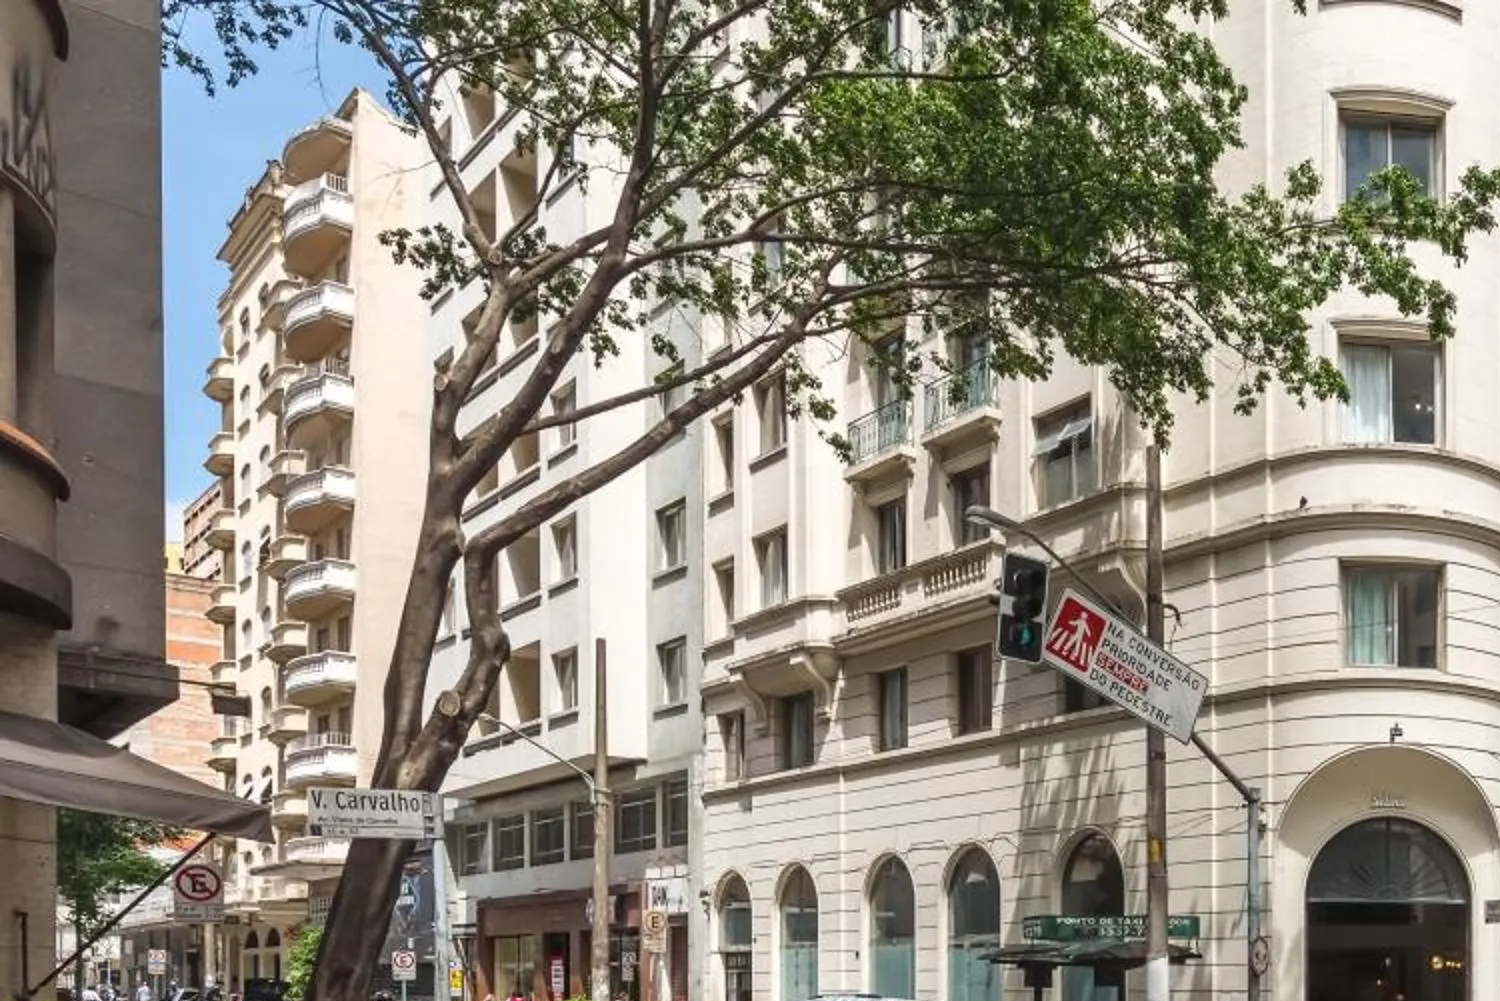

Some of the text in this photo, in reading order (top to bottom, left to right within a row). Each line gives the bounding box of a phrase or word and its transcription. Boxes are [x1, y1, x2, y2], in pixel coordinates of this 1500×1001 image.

[1096, 651, 1149, 693] SEMPRE
[1102, 638, 1173, 692] PRIORIDADE
[1107, 622, 1200, 691] NA CONVERSÃO
[1089, 668, 1173, 727] DO PEDESTRE
[311, 790, 420, 812] V. Carvalho
[651, 915, 659, 929] E
[1056, 917, 1143, 926] PONTO DE TAXI
